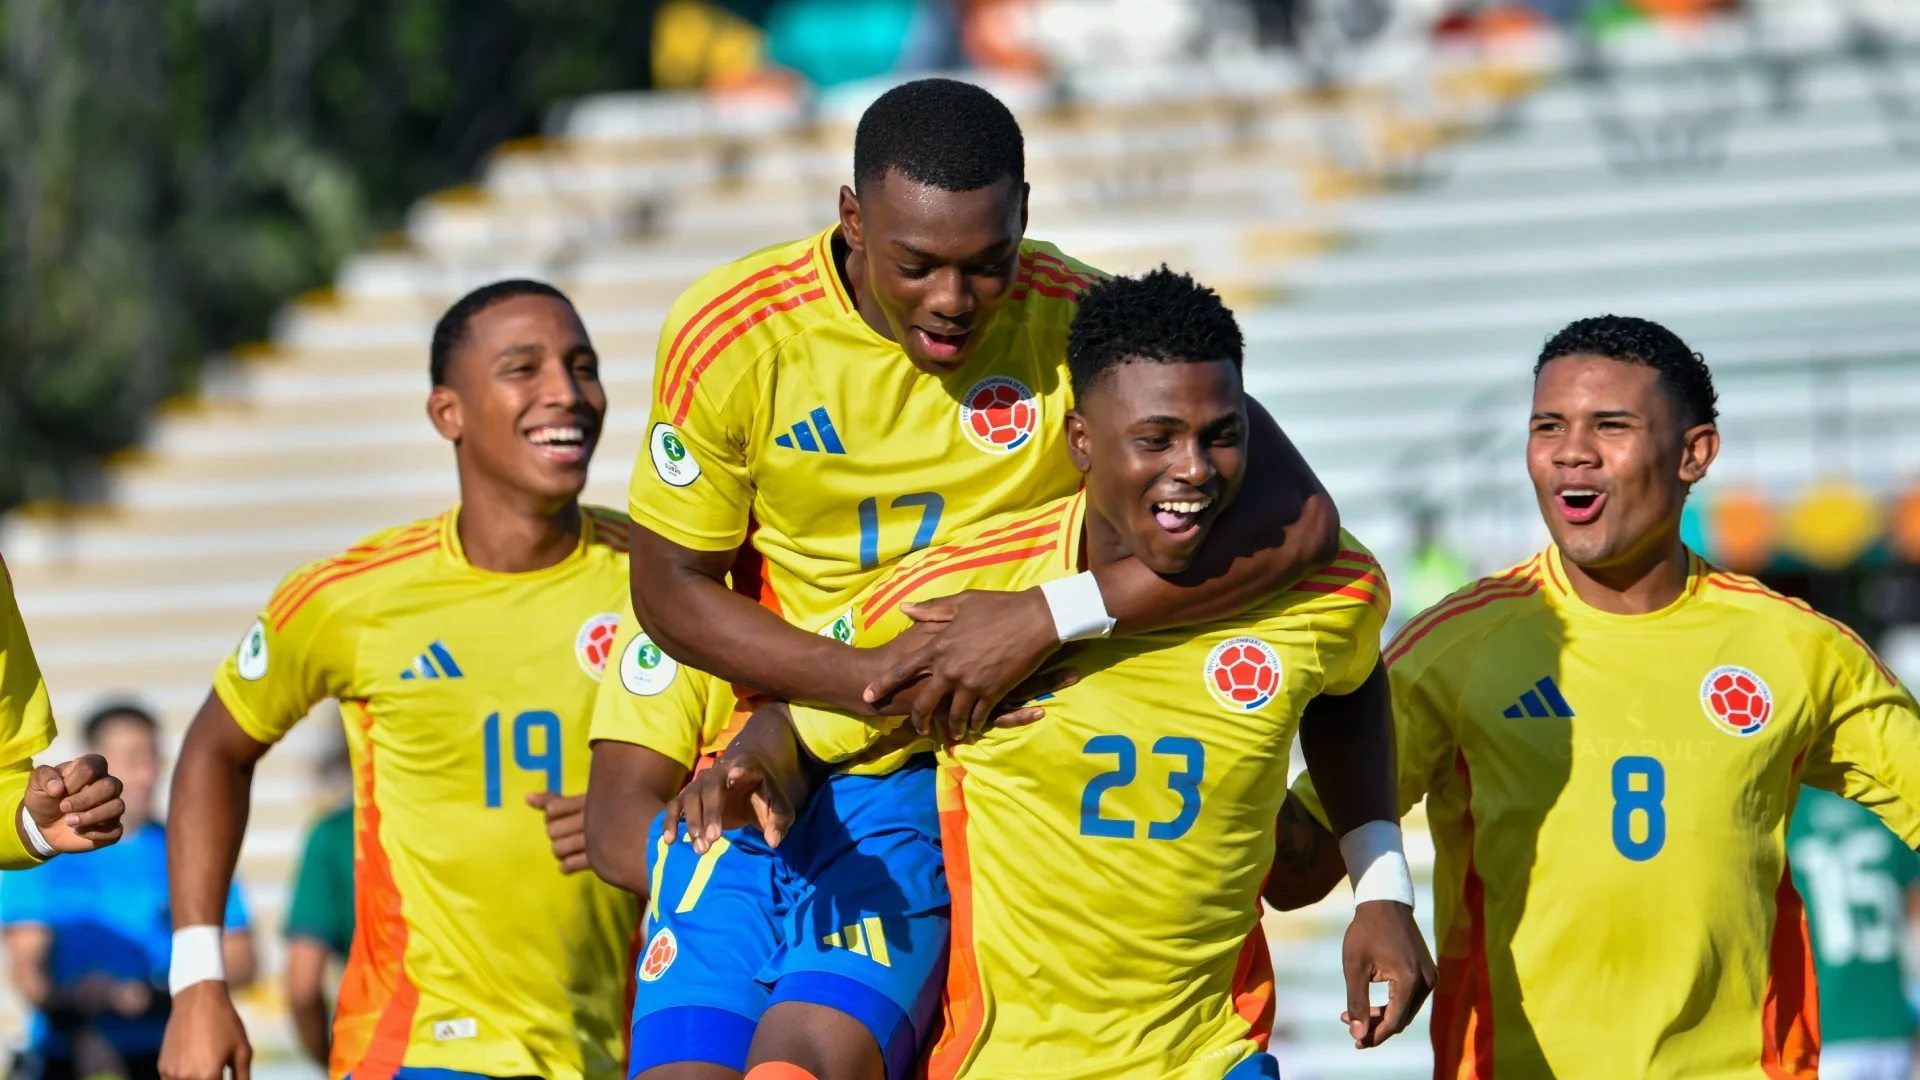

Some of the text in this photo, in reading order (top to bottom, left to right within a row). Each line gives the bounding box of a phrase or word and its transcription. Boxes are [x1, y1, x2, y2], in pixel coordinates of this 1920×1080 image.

[858, 491, 945, 569] 17
[1225, 638, 1262, 646] COLOMBIANA
[484, 710, 563, 808] 19
[1080, 735, 1205, 840] 23
[1555, 737, 1717, 761] CATAPULT
[1612, 756, 1666, 862] 8
[1793, 828, 1903, 968] 15
